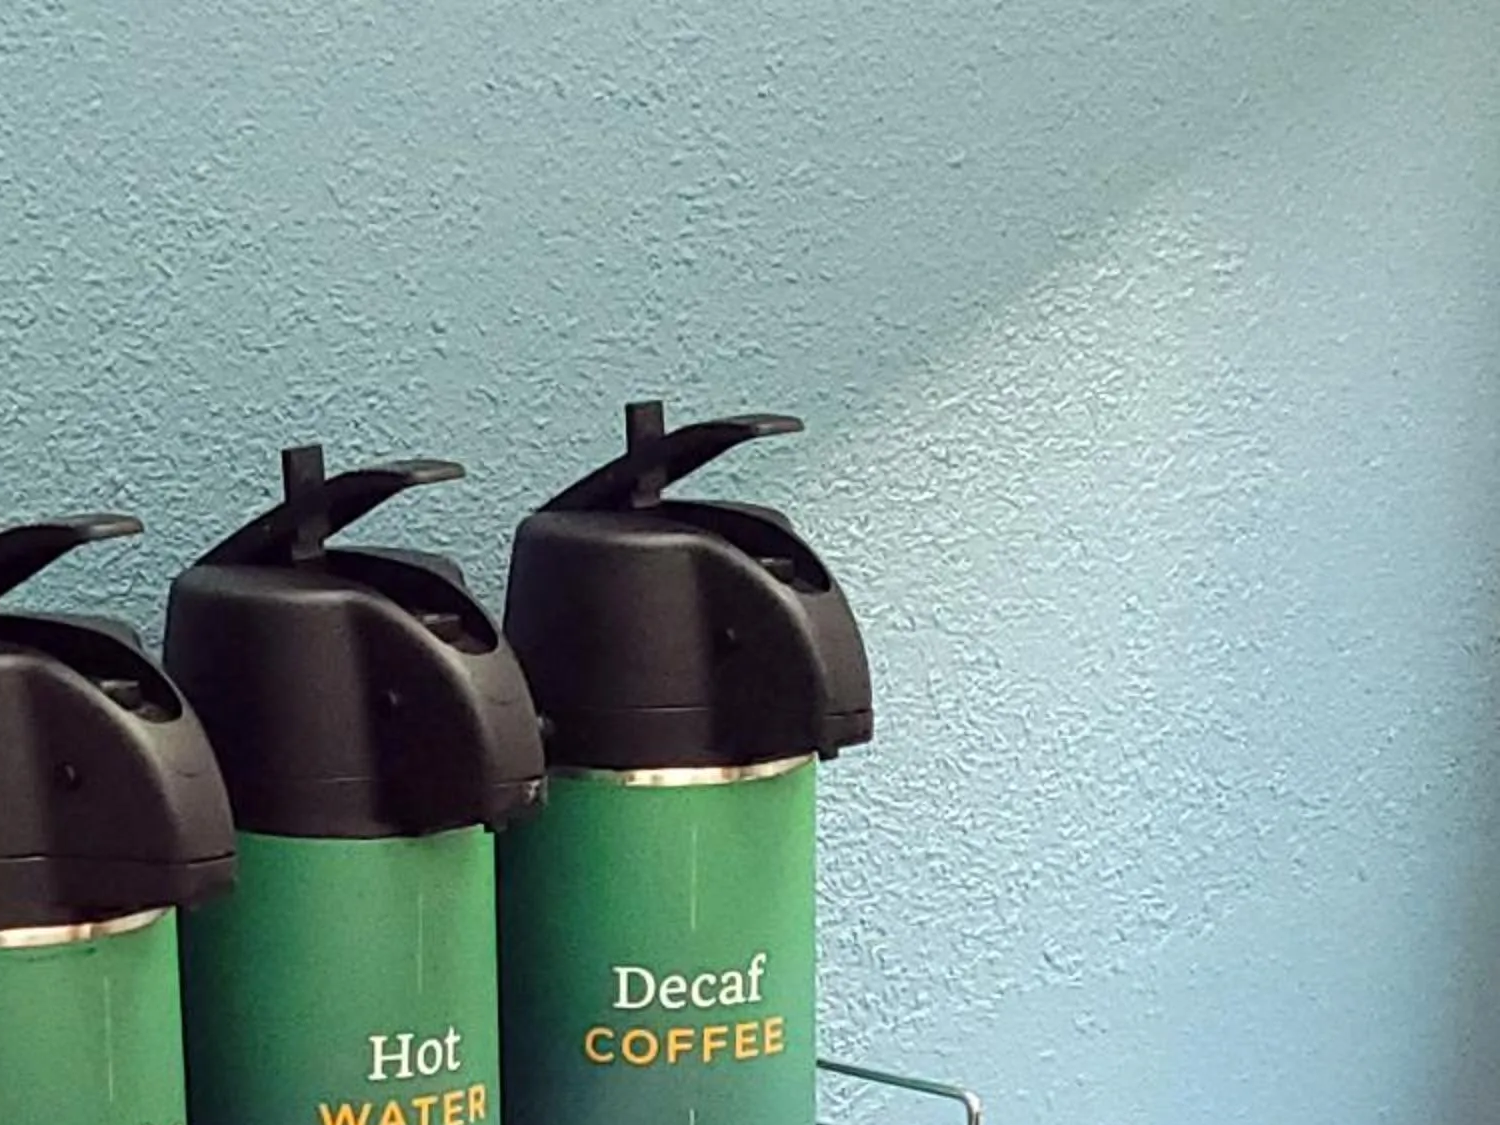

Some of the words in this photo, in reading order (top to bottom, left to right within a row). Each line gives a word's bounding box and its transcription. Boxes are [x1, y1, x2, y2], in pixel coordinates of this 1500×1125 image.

[612, 951, 768, 1010] Decaf
[367, 1025, 462, 1081] Hot
[584, 1015, 785, 1066] COFFEE
